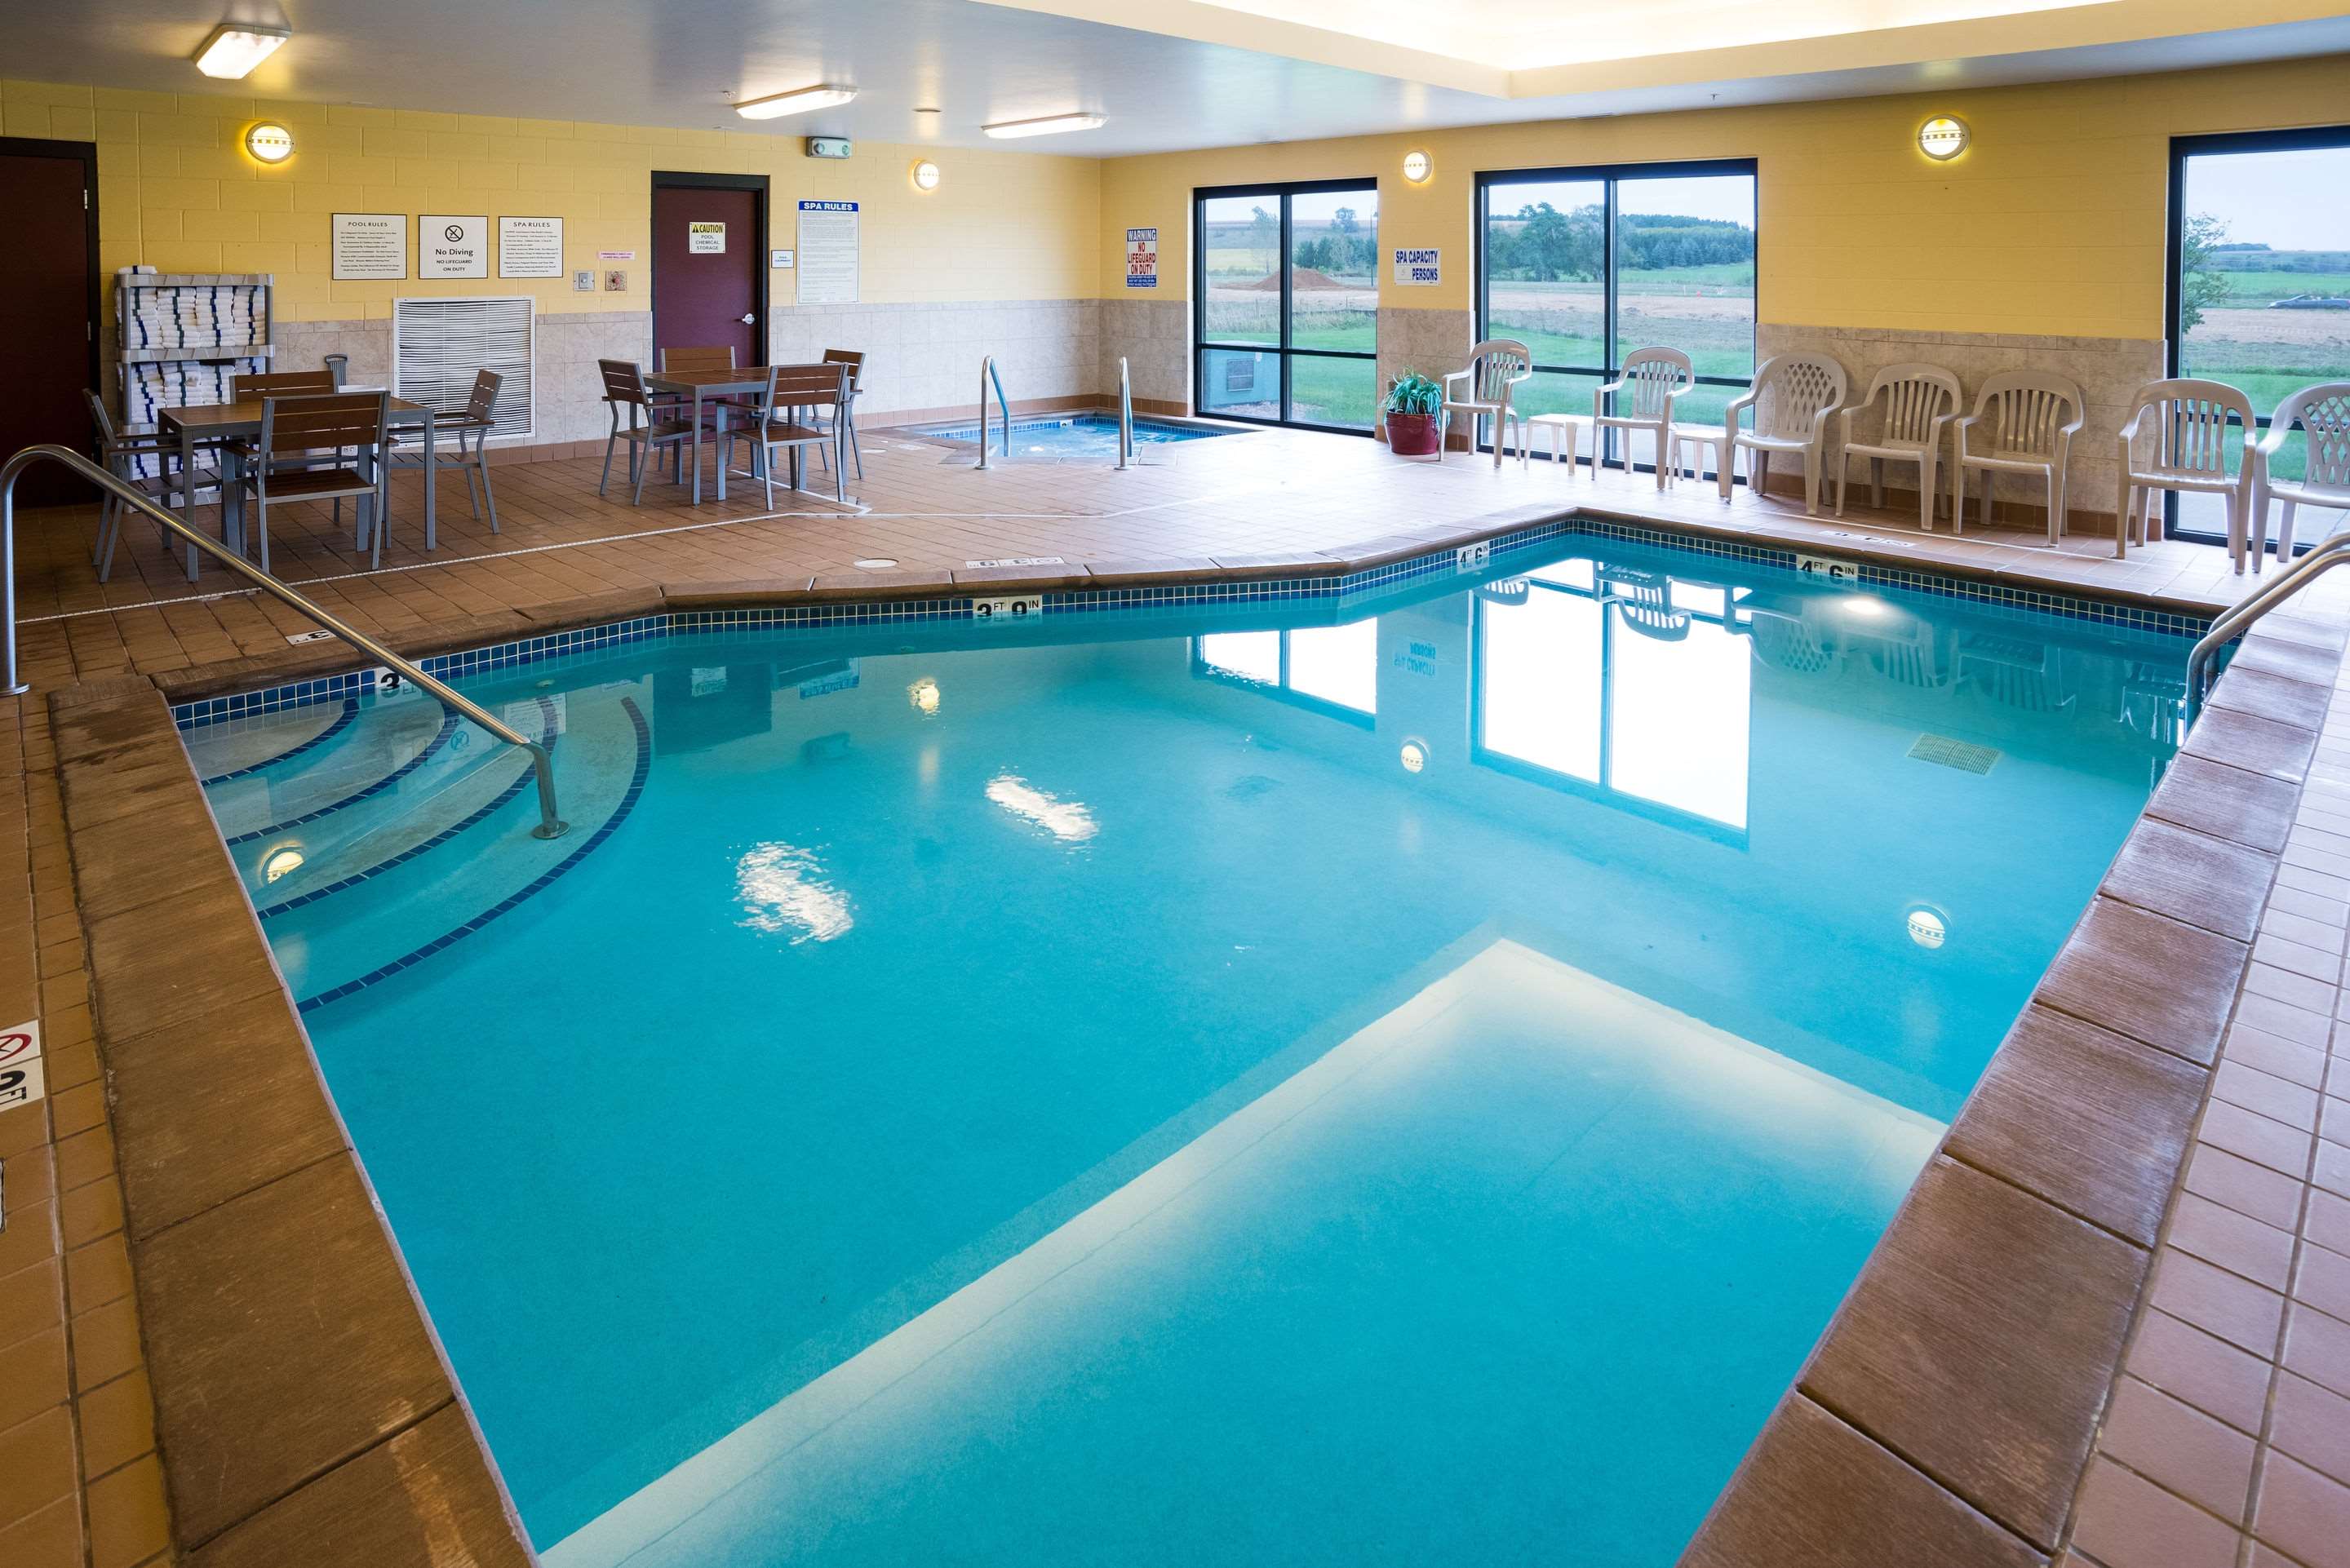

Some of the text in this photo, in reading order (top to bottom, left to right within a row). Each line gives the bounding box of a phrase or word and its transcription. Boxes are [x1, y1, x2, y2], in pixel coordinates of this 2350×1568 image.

[699, 224, 723, 233] CAUTION
[1128, 229, 1155, 241] WARNING
[1137, 241, 1146, 252] NO
[449, 248, 473, 257] Diving
[1396, 250, 1438, 264] SPA CAPACITY
[1128, 253, 1155, 264] LIFEGUARD
[1131, 264, 1153, 274] ON DUTY
[1412, 268, 1438, 281] PERSONS
[994, 602, 1004, 611] FT
[1028, 600, 1039, 609] IN
